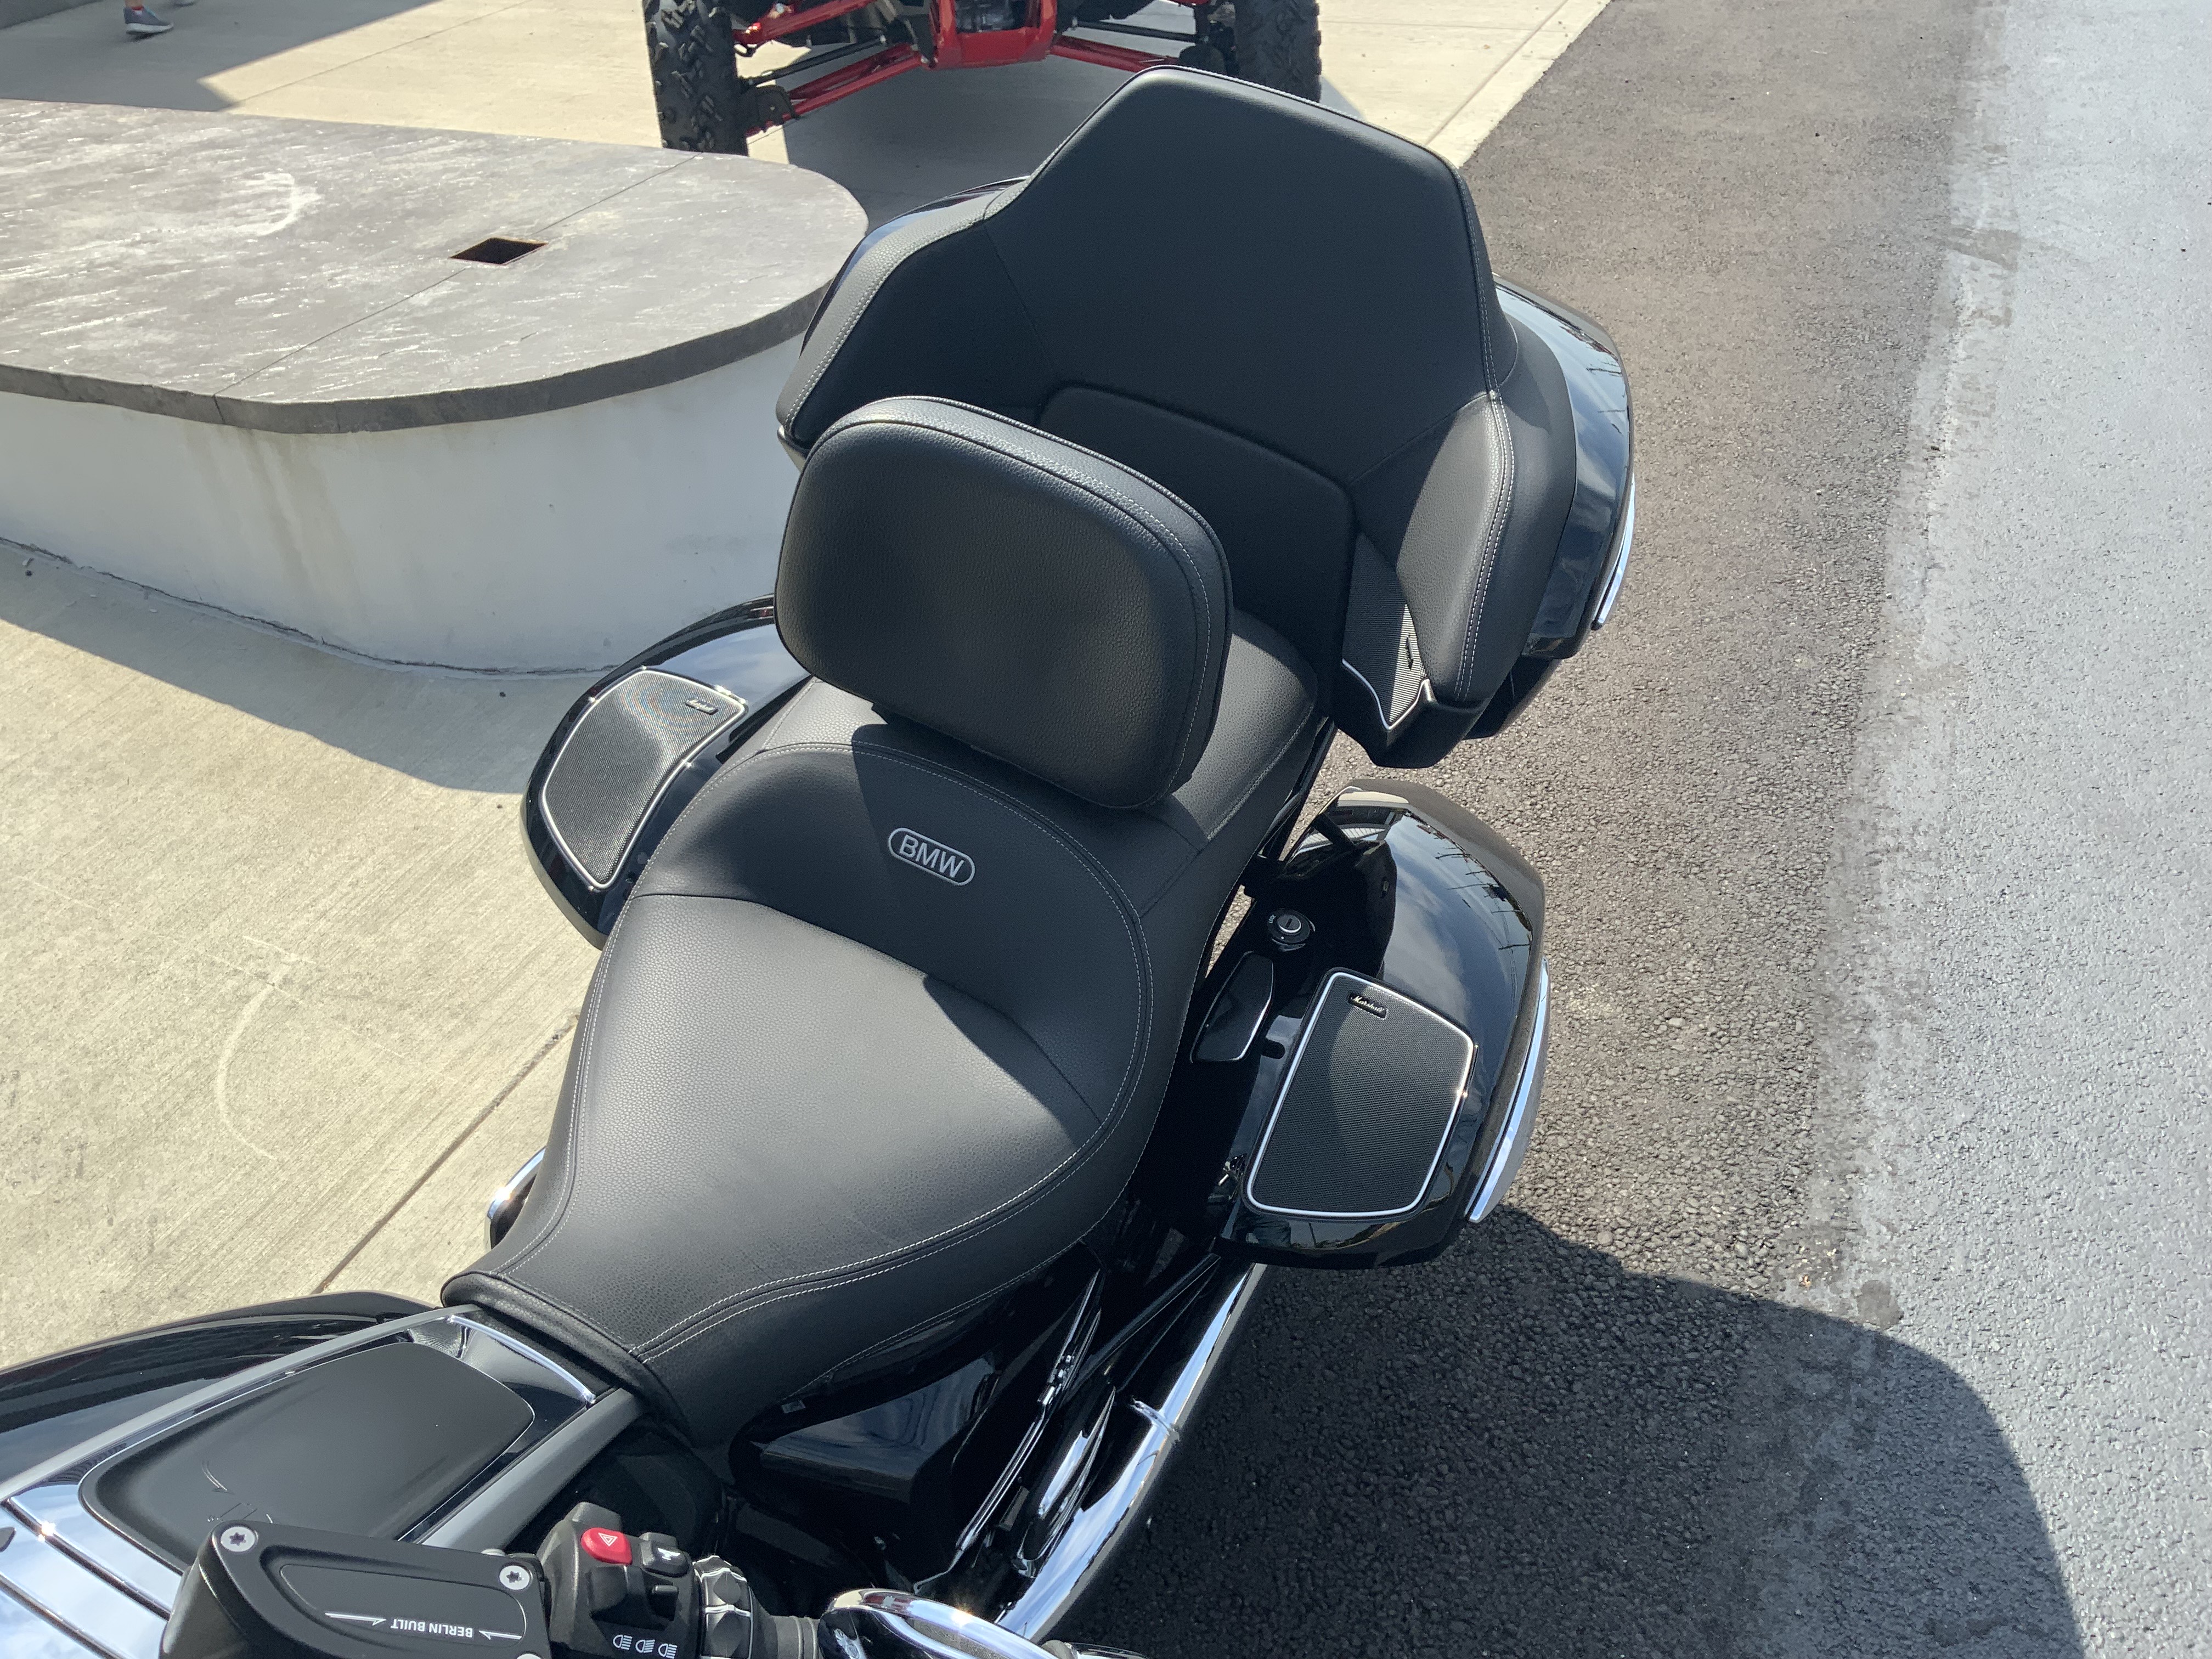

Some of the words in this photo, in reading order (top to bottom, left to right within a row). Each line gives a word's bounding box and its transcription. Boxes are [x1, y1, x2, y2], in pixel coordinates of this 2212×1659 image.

[899, 834, 965, 878] BMW
[1350, 995, 1385, 1013] Marshall
[390, 1618, 426, 1632] BUILT
[428, 1622, 473, 1638] BERLIN
